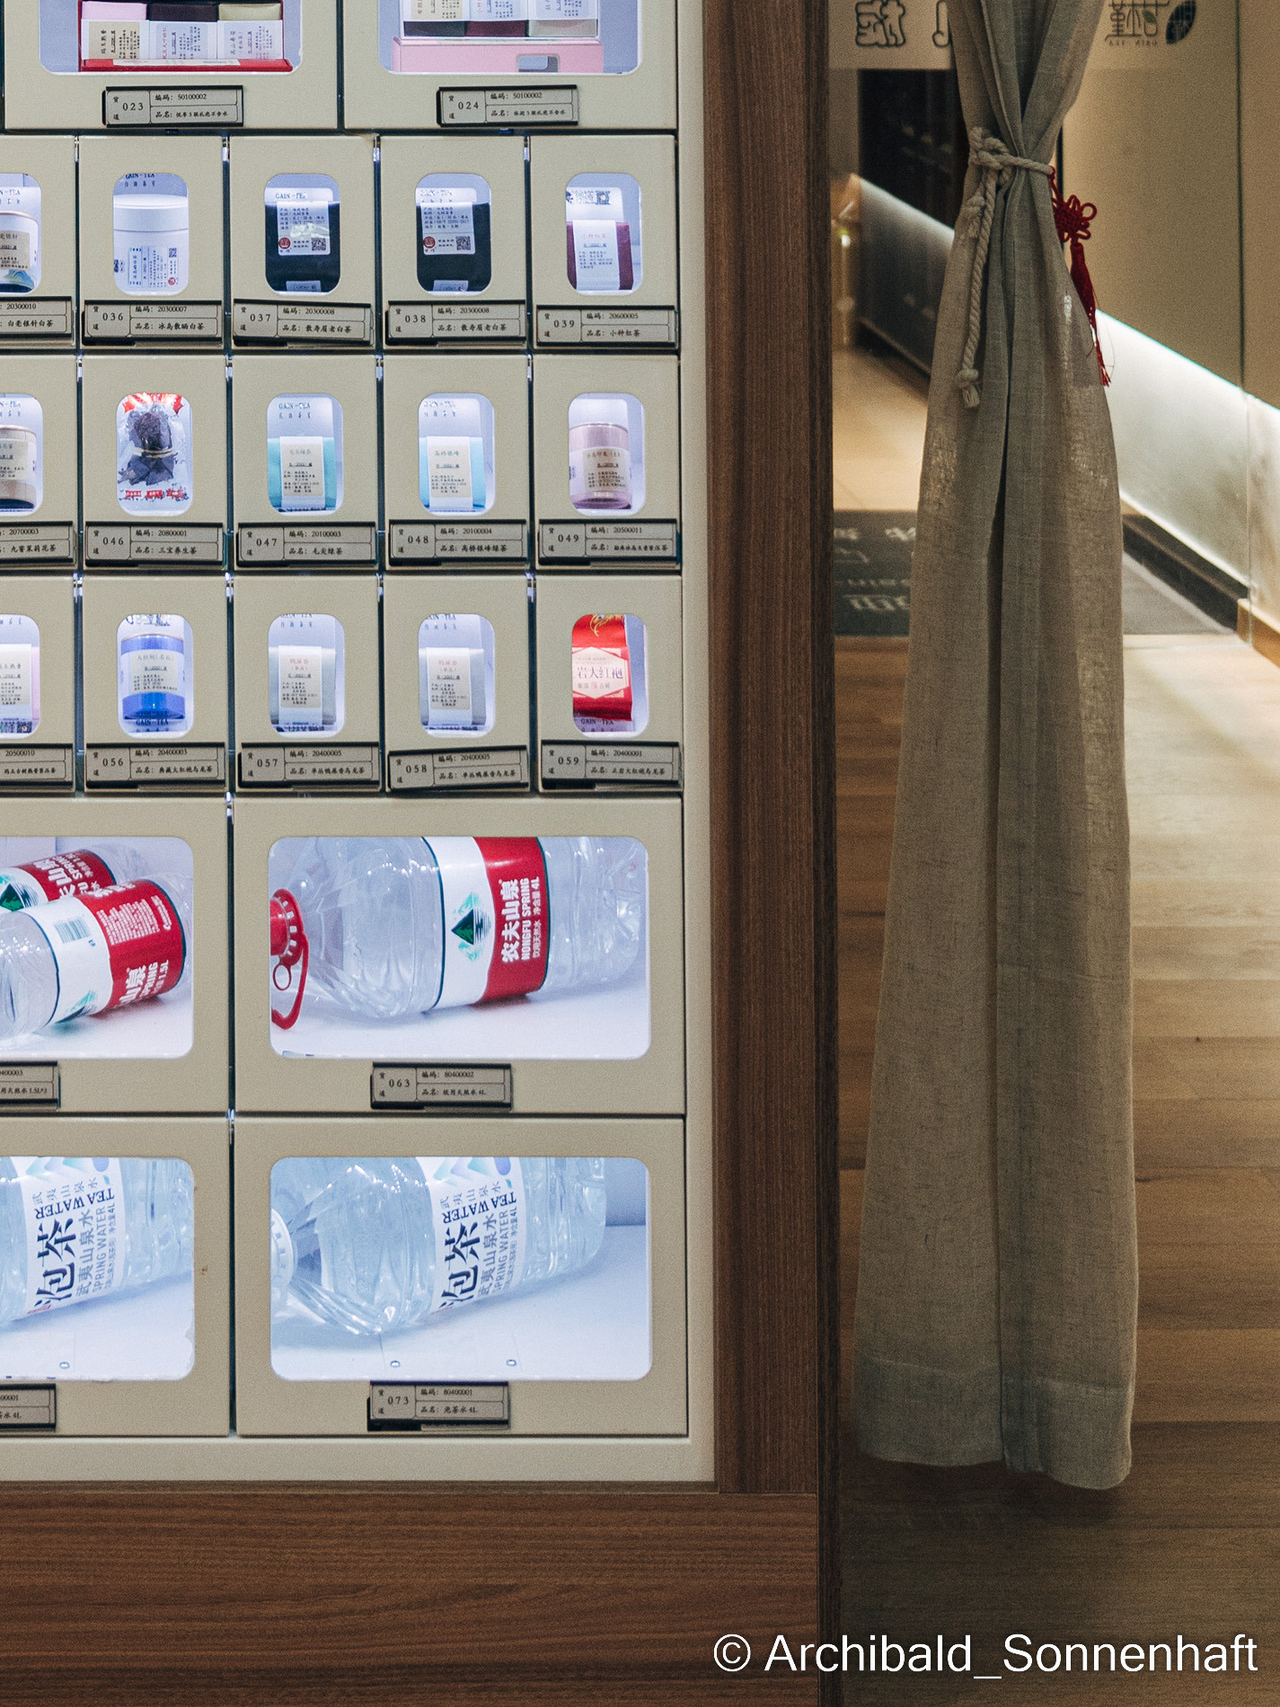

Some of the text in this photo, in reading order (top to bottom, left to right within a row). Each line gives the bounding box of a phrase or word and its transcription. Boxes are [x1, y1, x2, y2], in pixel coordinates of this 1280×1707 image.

[122, 102, 144, 111] 023
[457, 101, 479, 110] 024
[102, 312, 124, 322] 036
[249, 313, 271, 323] 037
[404, 314, 427, 324] 038
[553, 319, 575, 329] 039
[102, 536, 125, 546] 046
[255, 537, 278, 547] 047
[407, 535, 429, 545] 048
[557, 533, 580, 543] 049
[574, 666, 624, 680] 岩大红袍
[102, 757, 125, 767] 056
[256, 758, 279, 768] 057
[557, 756, 580, 765] 059
[405, 764, 428, 774] 058
[500, 879, 521, 963] 农夫山泉
[520, 877, 532, 961] NONGFU SPRING
[388, 1078, 410, 1088] 063
[33, 1187, 115, 1220] TEA WATER
[441, 1191, 517, 1224] TEA WATER
[94, 1206, 107, 1250] WATER
[497, 1210, 510, 1253] WATER
[34, 1217, 78, 1307] 泡茶
[440, 1221, 481, 1309] 泡茶
[387, 1396, 409, 1405] 073
